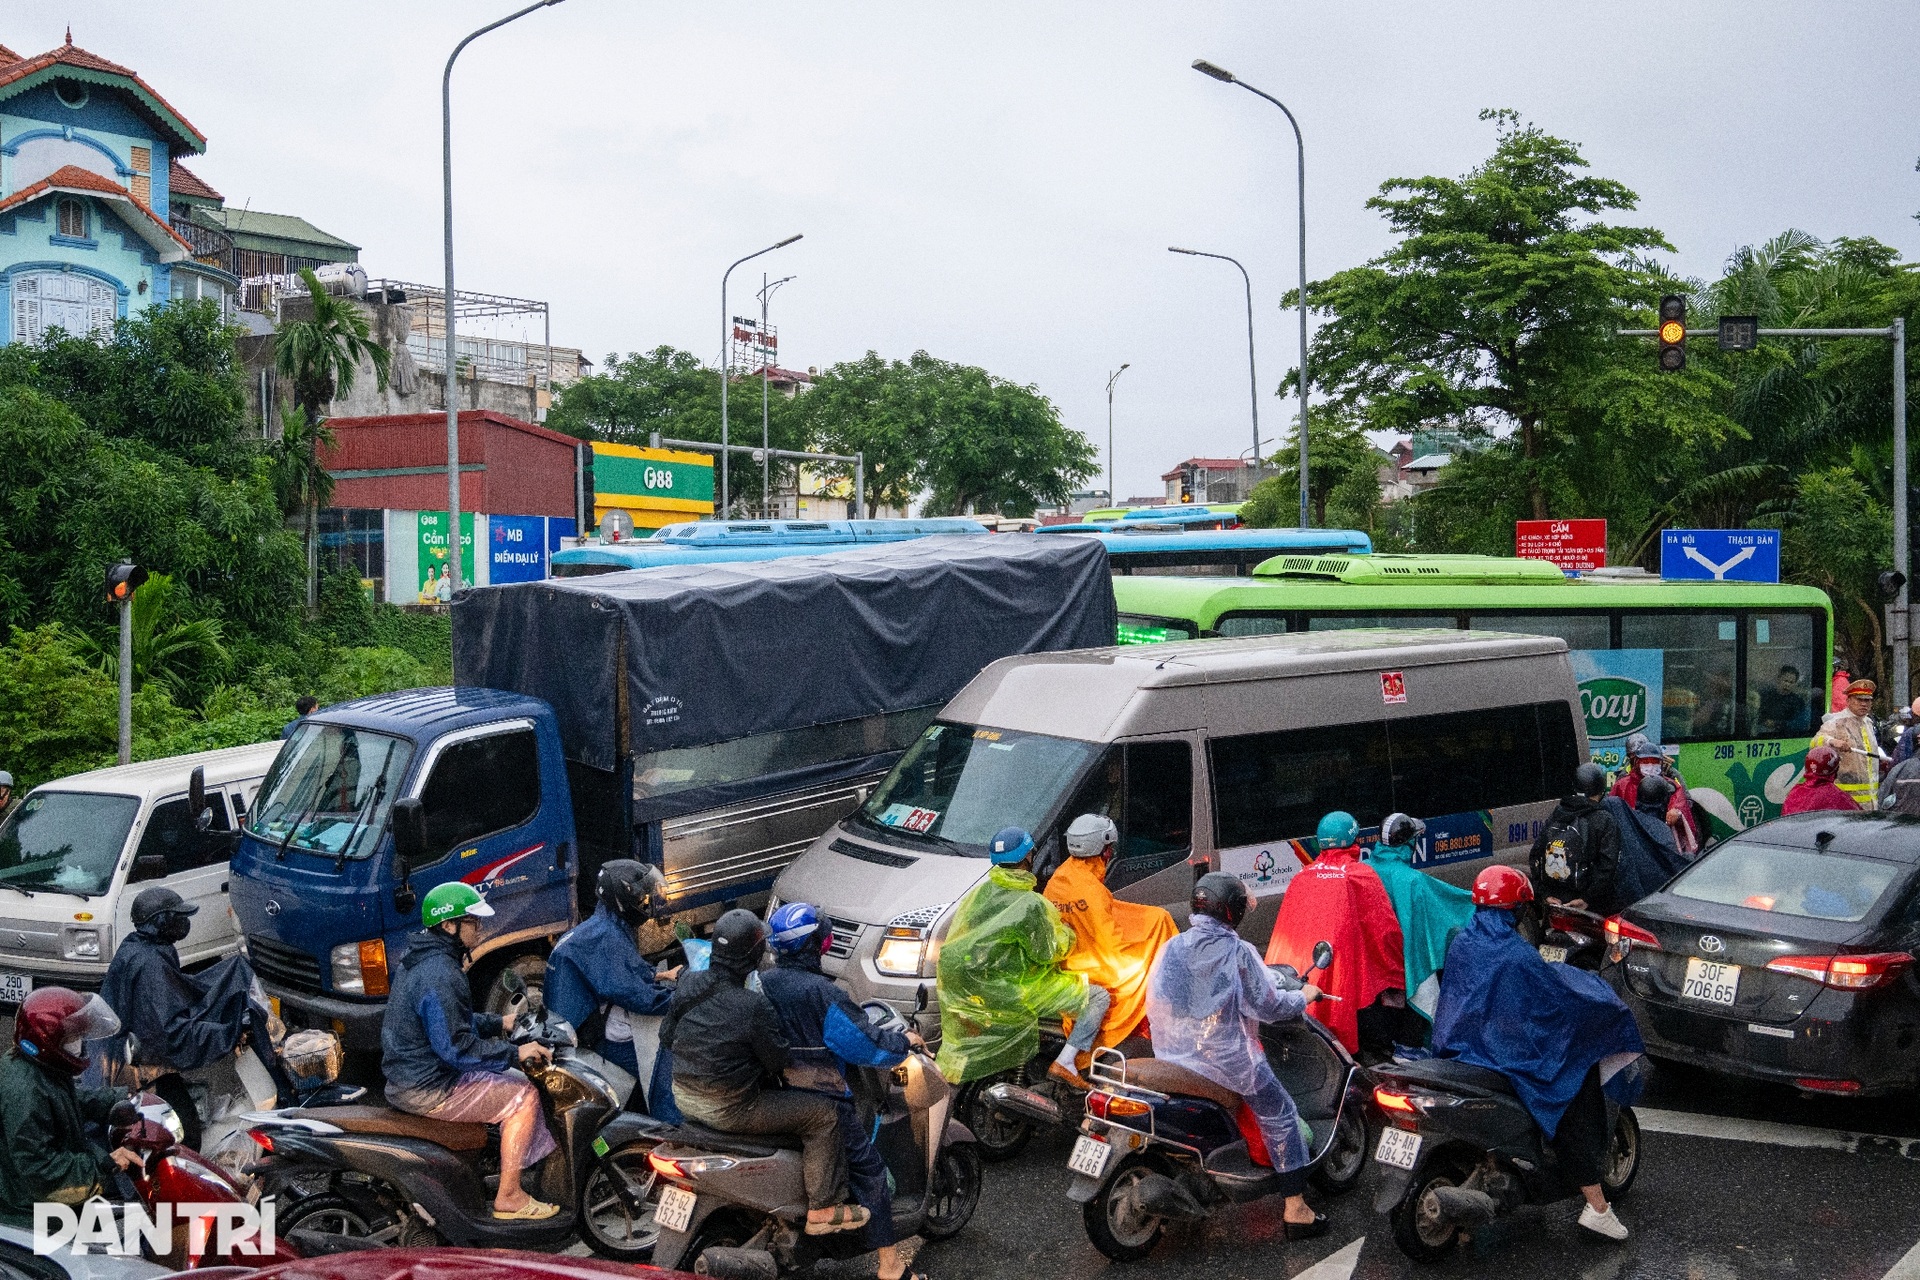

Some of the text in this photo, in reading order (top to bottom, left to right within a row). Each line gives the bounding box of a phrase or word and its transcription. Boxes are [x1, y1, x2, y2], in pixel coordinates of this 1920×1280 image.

[507, 528, 523, 542] MB
[1550, 520, 1570, 533] CẤM
[422, 529, 444, 545] Cần
[1667, 533, 1695, 545] HÀ NỘI
[1727, 534, 1773, 546] THẠCH BÀN
[515, 552, 529, 566] ĐẠI
[530, 551, 539, 564] LÝ
[1579, 688, 1638, 727] Cozy
[1714, 744, 1734, 760] 29B
[1746, 742, 1780, 758] 187.73
[1509, 823, 1527, 842] 89H
[1239, 865, 1293, 881] Edison Schools
[1316, 872, 1345, 880] logistics
[430, 902, 455, 917] Grab
[1698, 962, 1727, 982] 30F
[6, 975, 22, 988] 29D
[1684, 978, 1735, 1003] 706.65
[1079, 1139, 1106, 1159] 30-F9
[1385, 1130, 1416, 1151] 29-AH
[1072, 1154, 1099, 1174] 7486
[1377, 1145, 1415, 1167] 084.25
[664, 1189, 690, 1212] 29-G2
[657, 1205, 687, 1231] 152.21
